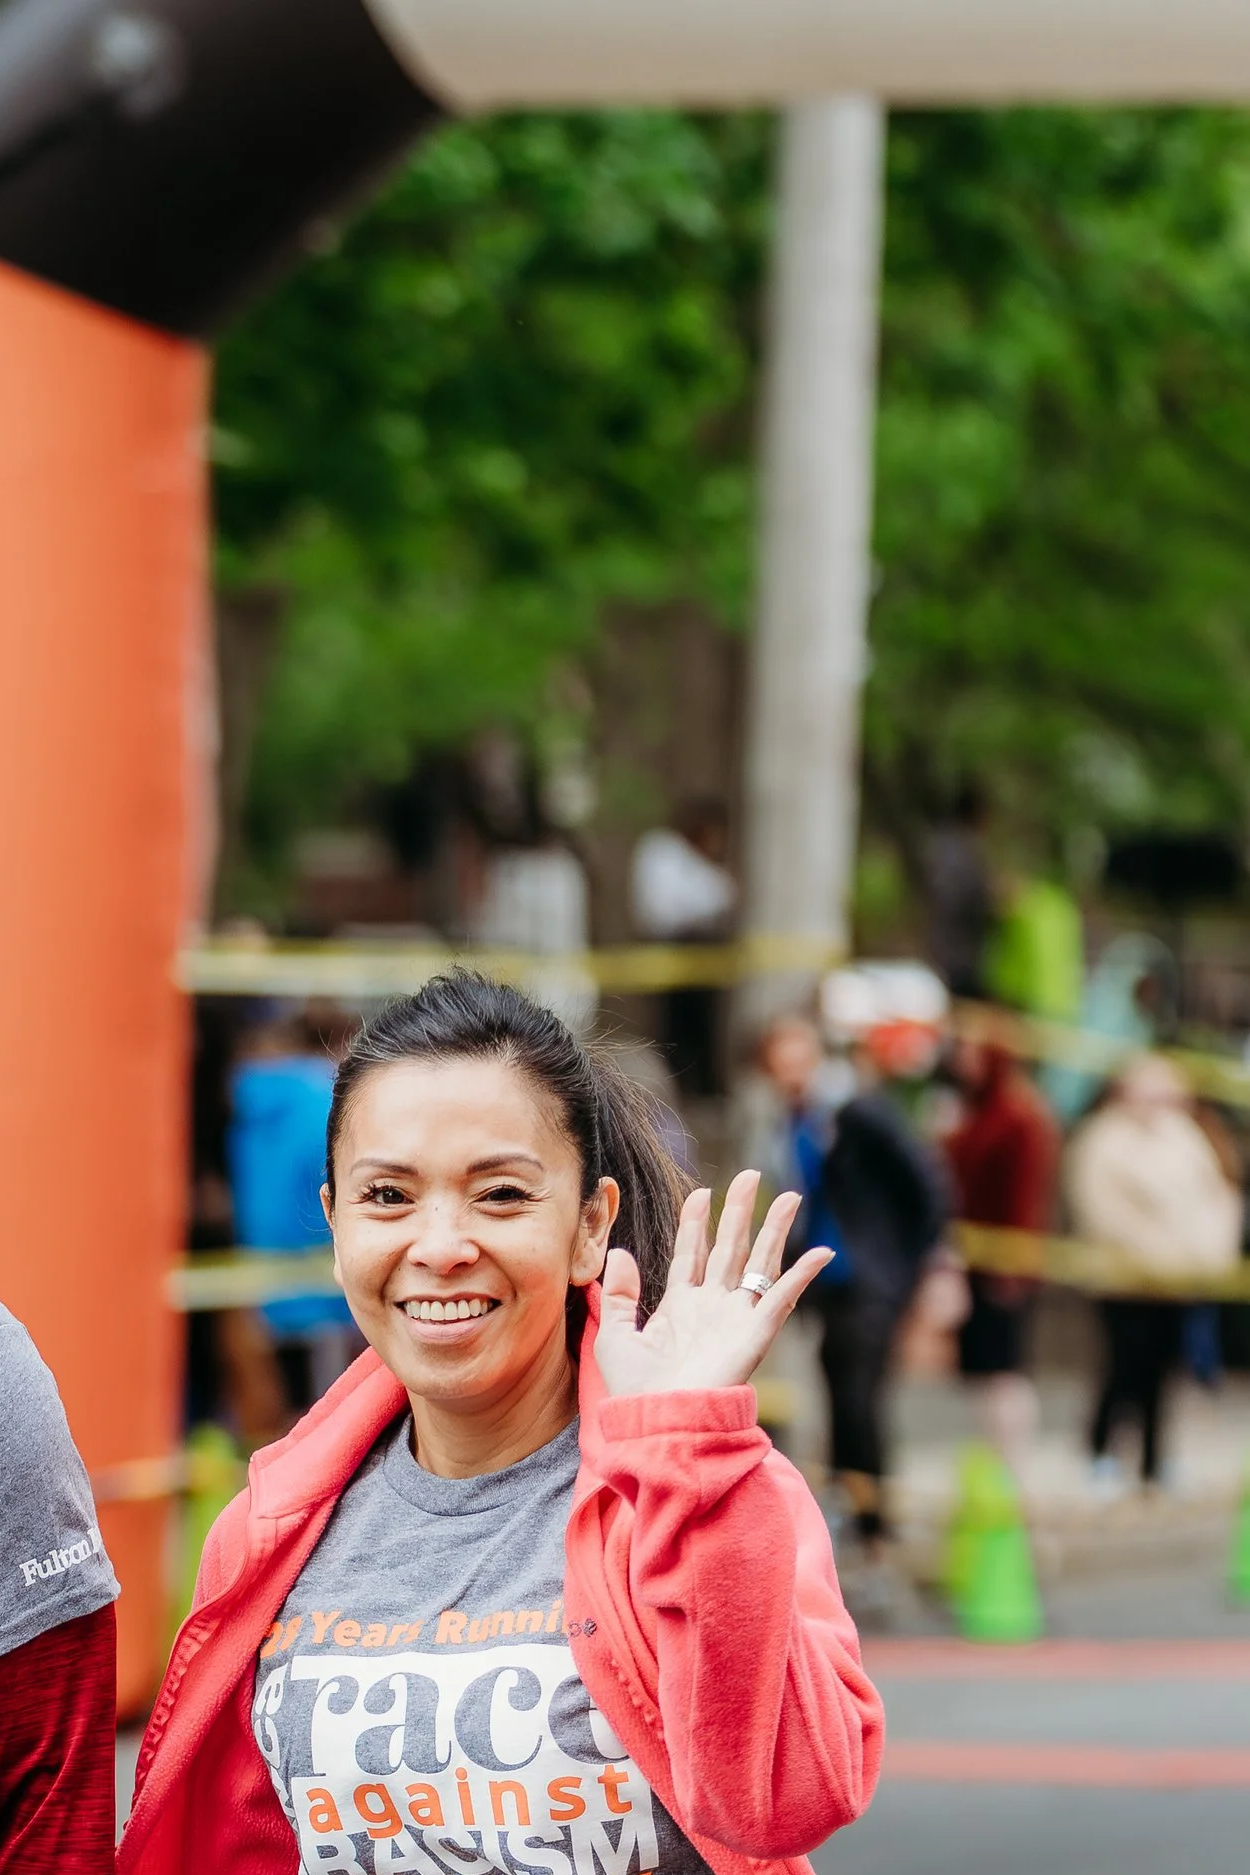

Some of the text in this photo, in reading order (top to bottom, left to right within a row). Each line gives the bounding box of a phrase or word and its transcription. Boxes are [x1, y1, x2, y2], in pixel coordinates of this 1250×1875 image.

[19, 1538, 92, 1587] Fulton
[311, 1609, 425, 1648] Years
[291, 1666, 631, 1778] race
[305, 1764, 632, 1840] against
